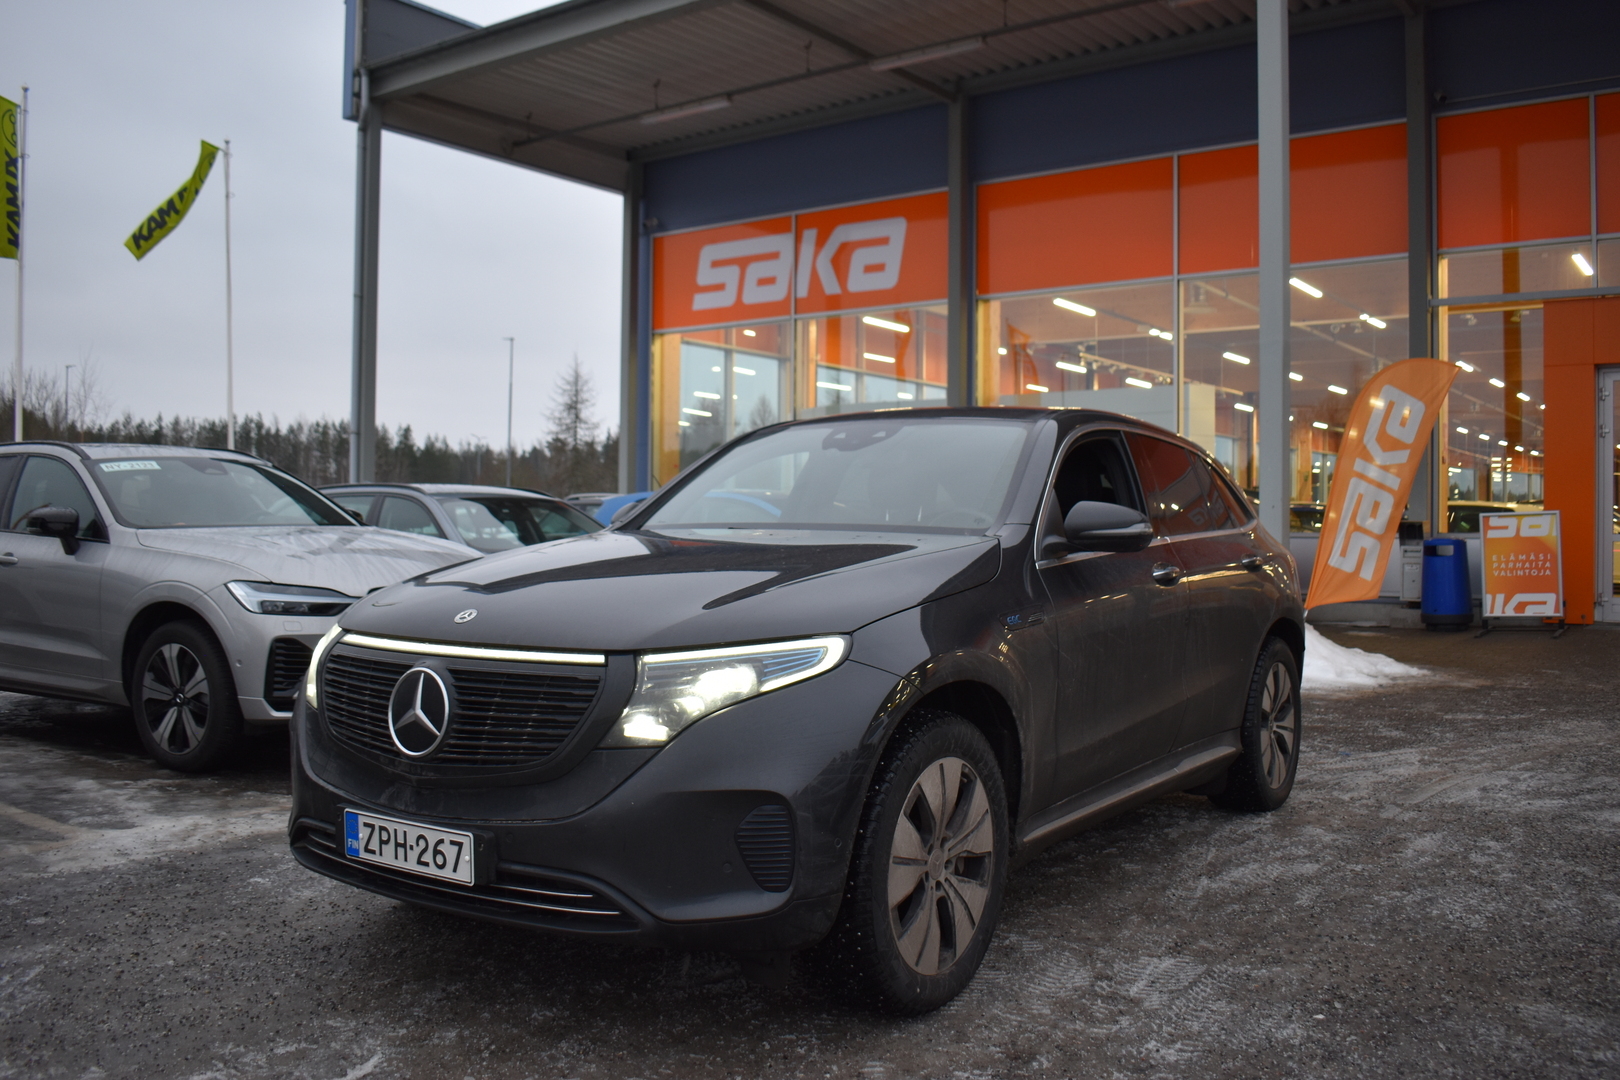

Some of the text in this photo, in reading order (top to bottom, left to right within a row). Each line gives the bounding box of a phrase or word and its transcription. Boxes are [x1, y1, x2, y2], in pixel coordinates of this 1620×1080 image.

[691, 216, 908, 311] saka
[1327, 384, 1426, 581] saka
[1492, 552, 1551, 562] ELÄMÄSI
[1492, 561, 1551, 569] PARHAITA
[1492, 569, 1552, 577] VALINTOJA
[348, 838, 359, 850] FIN
[362, 821, 464, 873] ZPH-267
